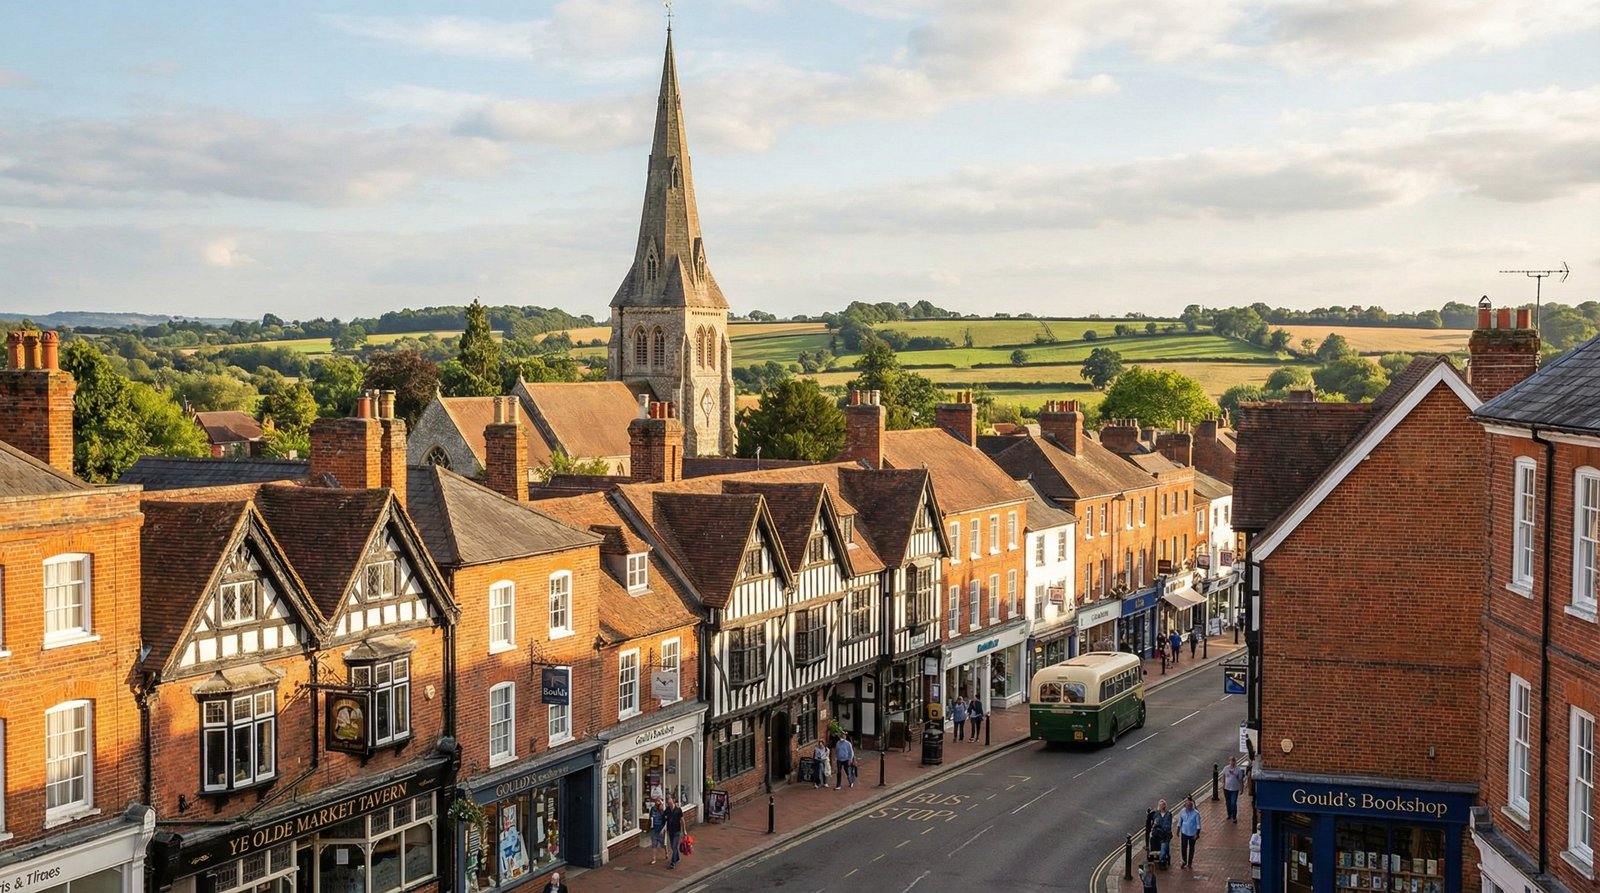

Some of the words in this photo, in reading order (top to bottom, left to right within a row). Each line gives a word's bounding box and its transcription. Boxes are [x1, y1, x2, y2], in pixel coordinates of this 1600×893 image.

[906, 793, 970, 805] BUS
[1292, 788, 1356, 808] Gould's
[1361, 793, 1448, 818] Bookshop
[230, 834, 250, 856] YE
[253, 821, 294, 848] OLDE
[297, 800, 356, 834] MARKET
[358, 782, 408, 811] TAVERN
[0, 880, 11, 893] is
[14, 877, 24, 890] &
